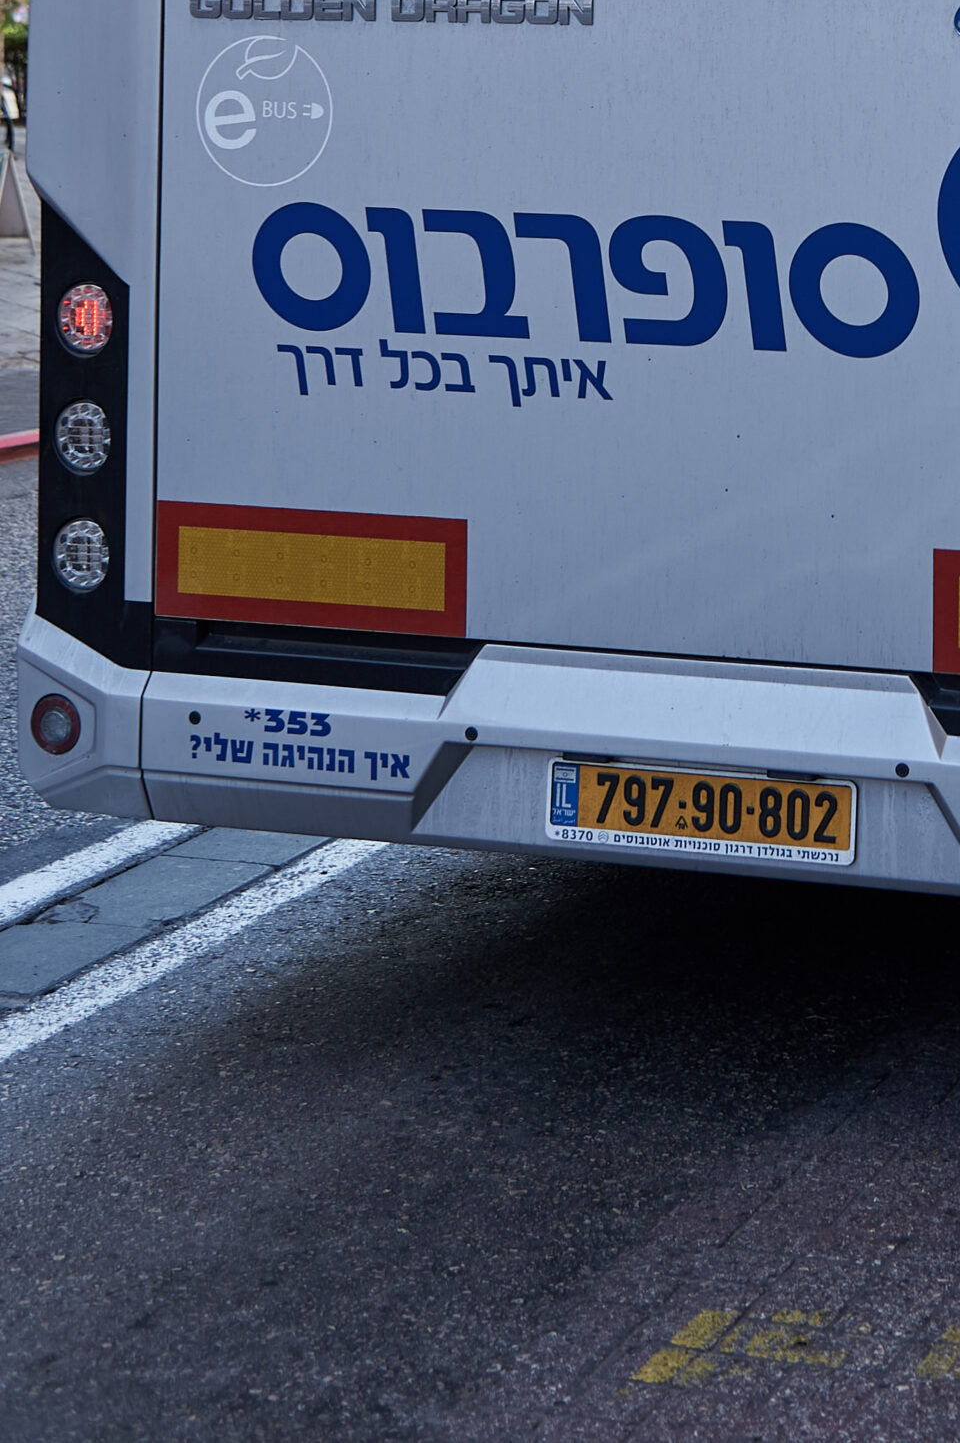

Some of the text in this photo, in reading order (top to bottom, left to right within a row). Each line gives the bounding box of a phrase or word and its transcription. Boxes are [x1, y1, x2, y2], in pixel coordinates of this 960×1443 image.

[262, 100, 297, 119] BUS
[252, 201, 920, 359] סופרבוס
[277, 339, 613, 407] איתך בכל דרך
[190, 733, 411, 781] איך הנהיגה שלי?
[555, 783, 572, 809] IL
[613, 833, 671, 848] אוטובוסים
[725, 843, 753, 855] דרגון
[757, 845, 793, 858] בגולדן
[797, 849, 840, 862] נרכשתי
